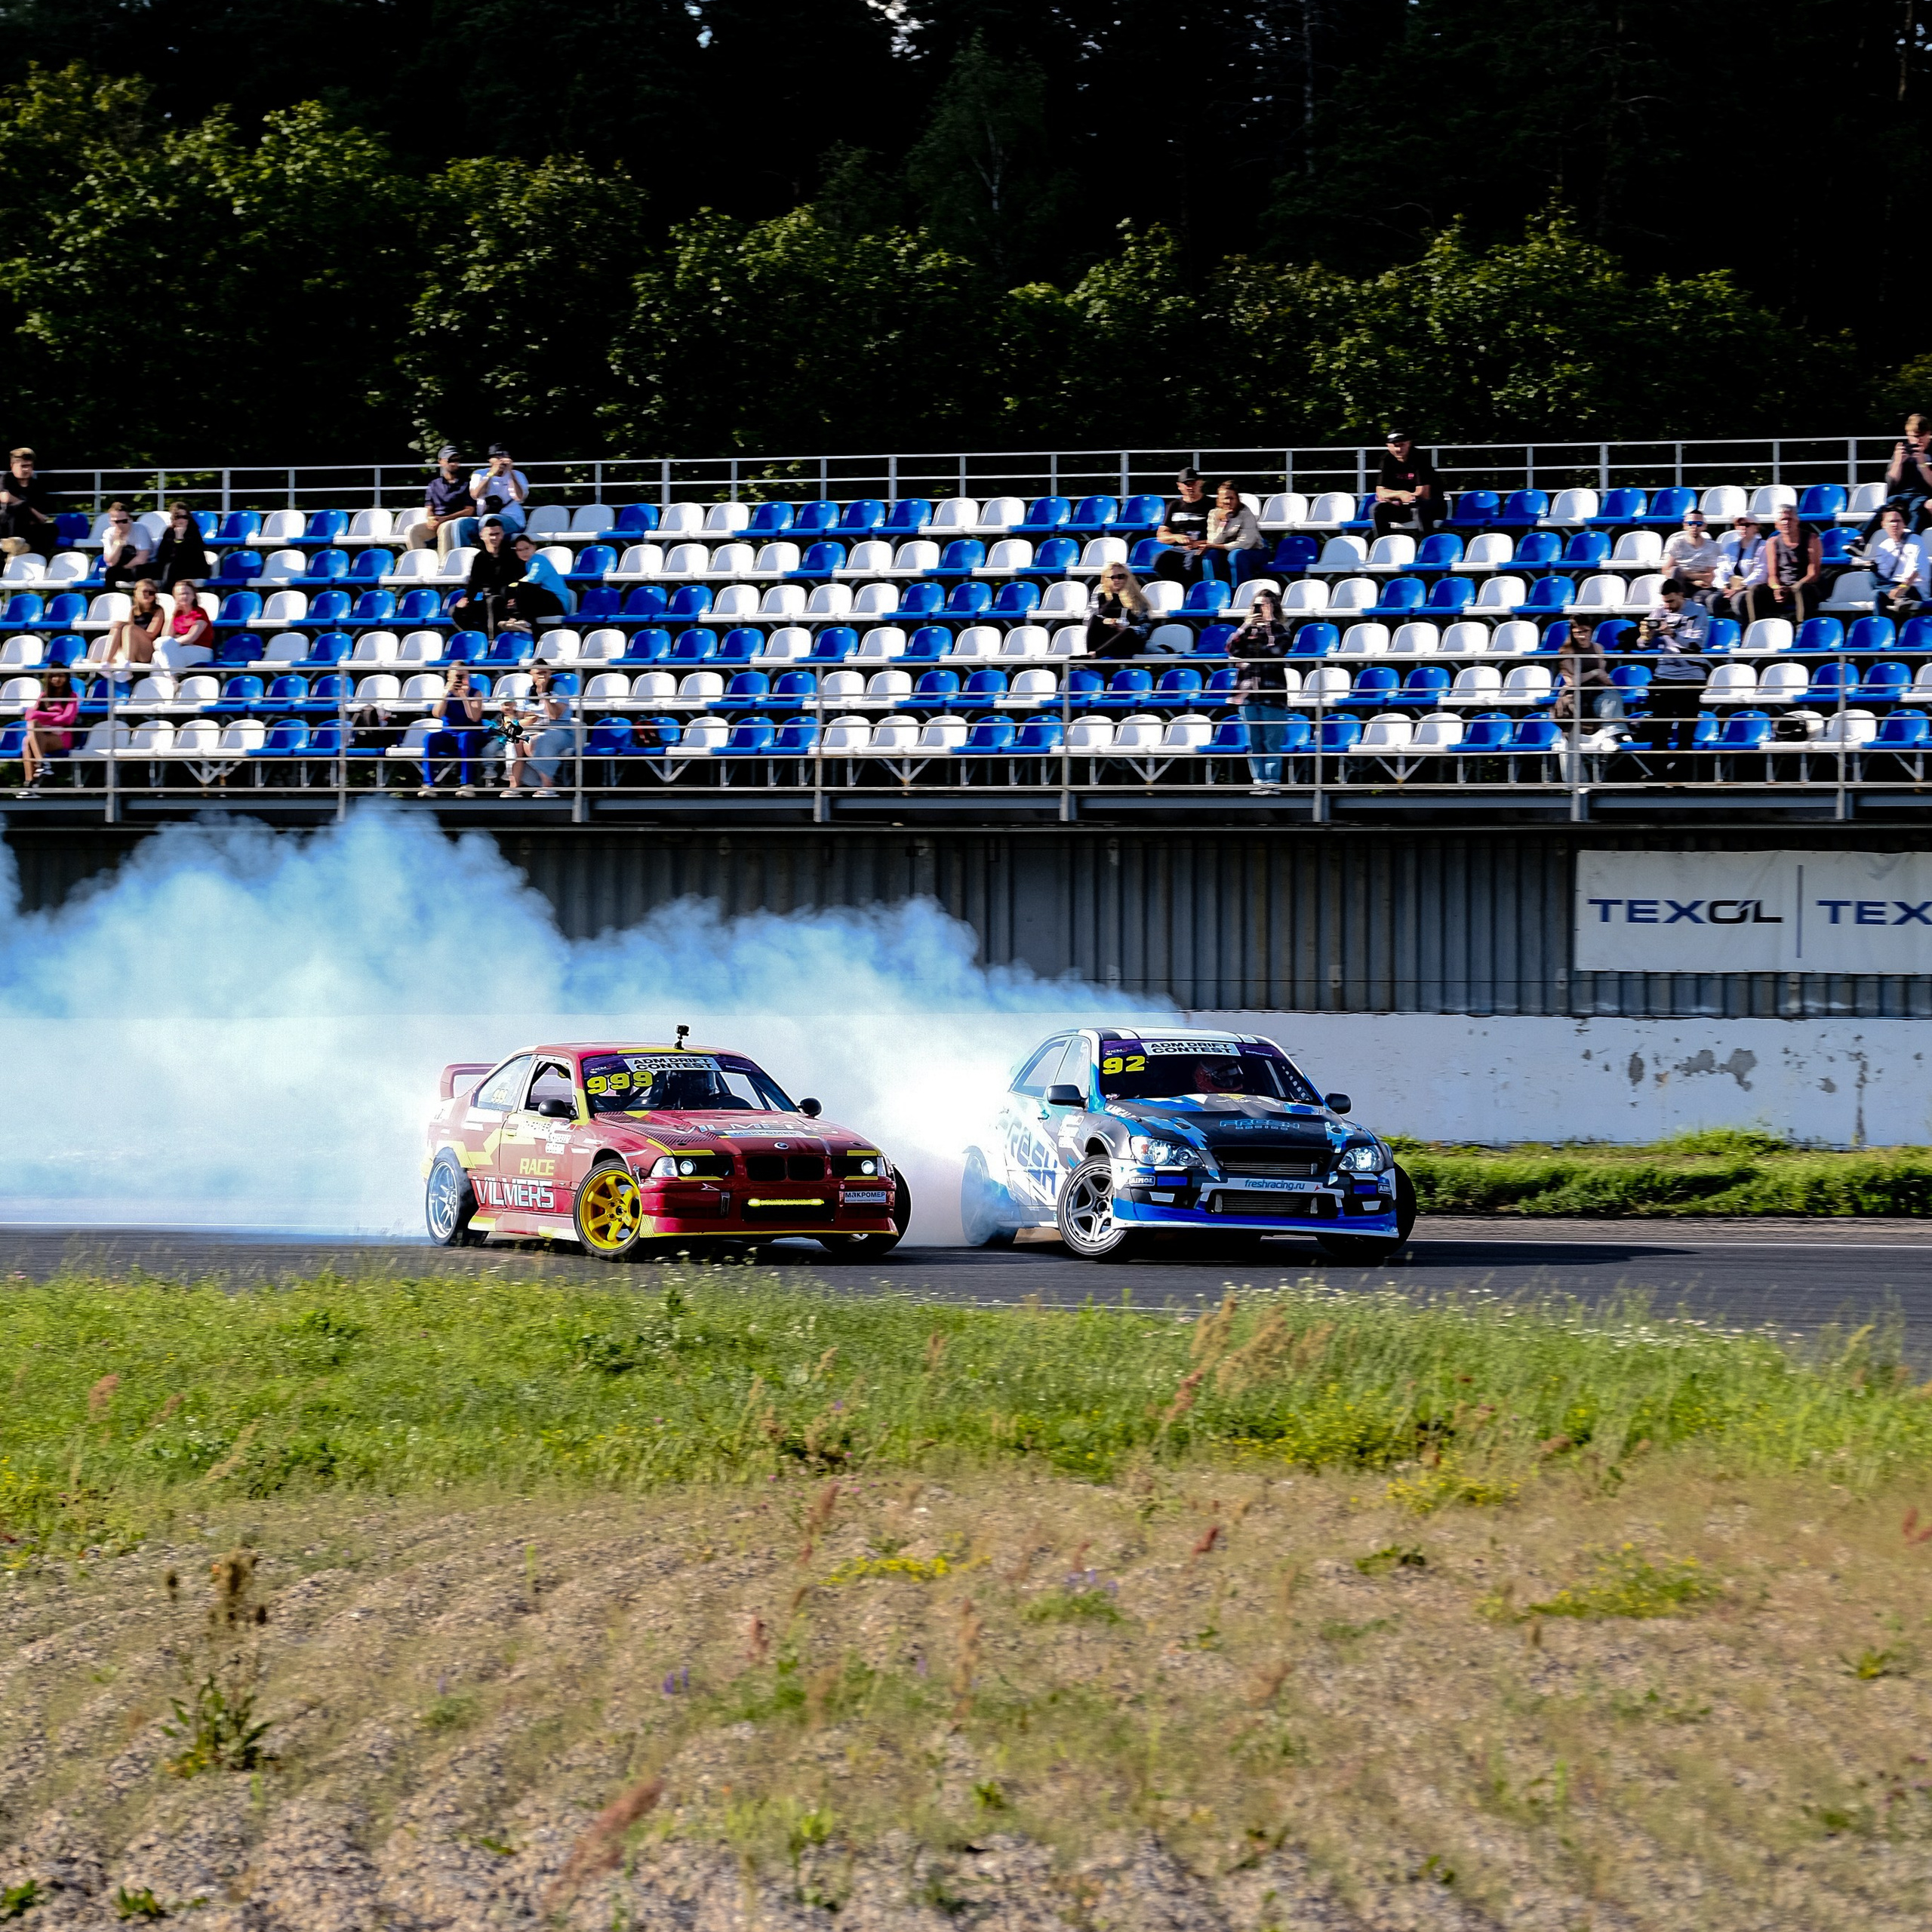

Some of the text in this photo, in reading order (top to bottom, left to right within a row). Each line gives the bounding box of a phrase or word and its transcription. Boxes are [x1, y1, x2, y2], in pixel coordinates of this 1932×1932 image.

[1588, 899, 1783, 924] TEXOL
[1103, 1056, 1145, 1075] 92
[587, 1071, 653, 1094] 999
[519, 1158, 555, 1176] RACE
[472, 1176, 555, 1208] VILMERS
[1244, 1179, 1306, 1190] freshracing.ru
